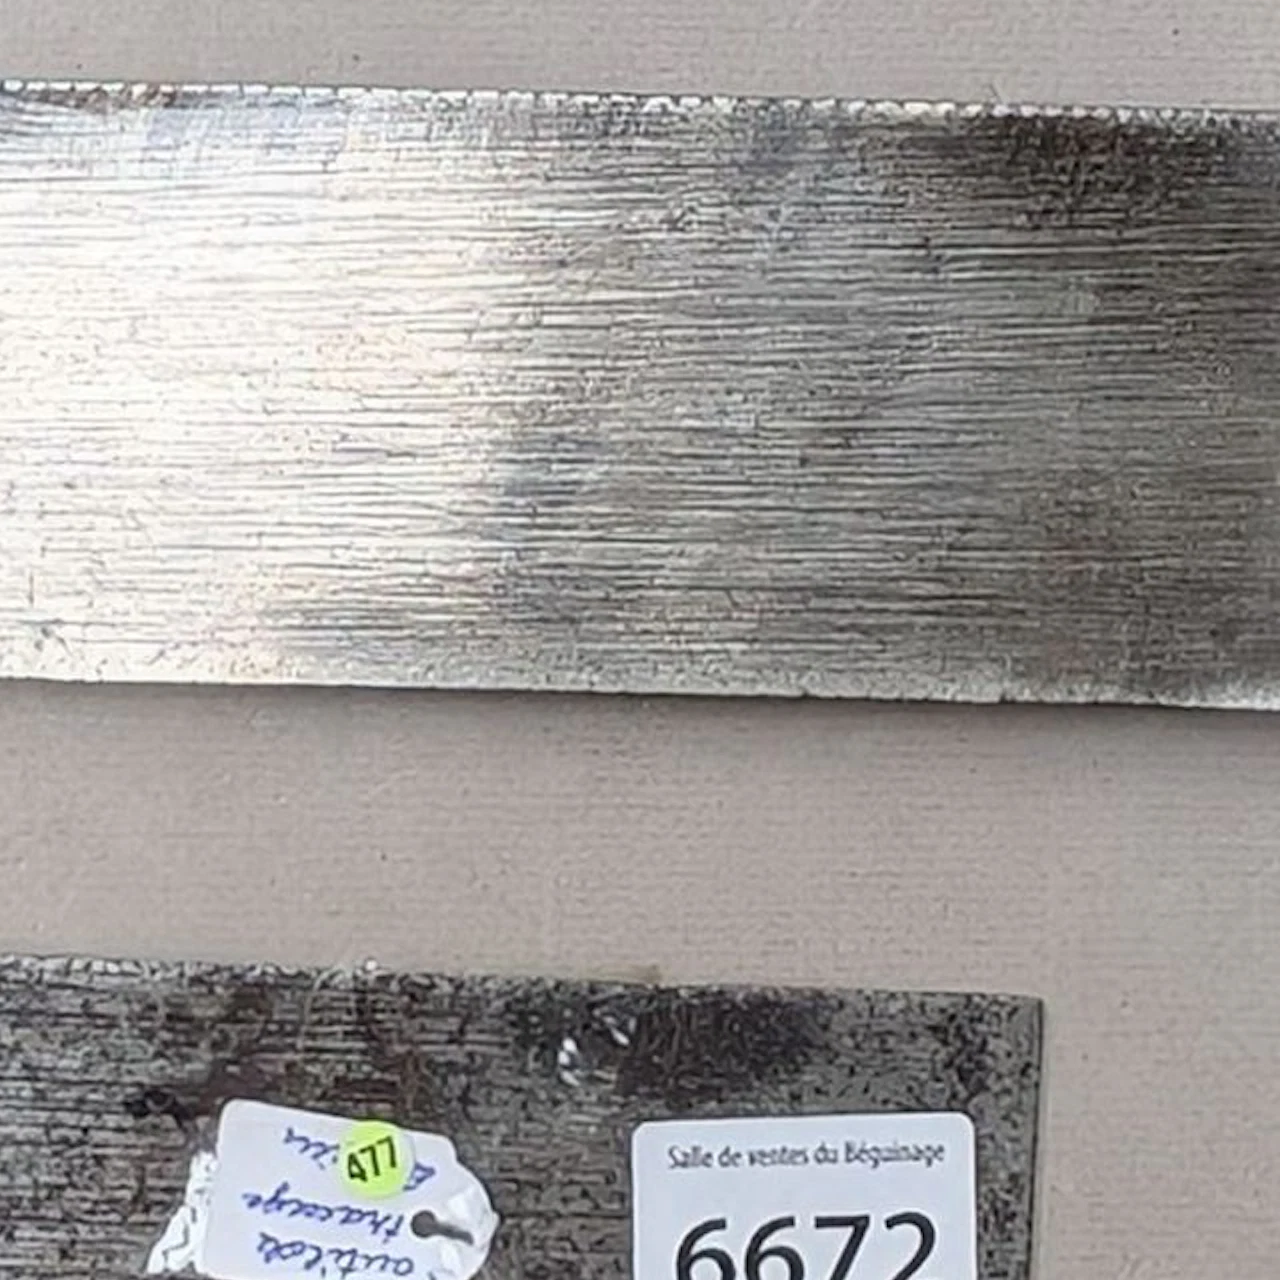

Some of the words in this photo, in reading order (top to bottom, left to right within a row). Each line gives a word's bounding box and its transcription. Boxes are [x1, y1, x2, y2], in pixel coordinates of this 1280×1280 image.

[346, 1136, 398, 1183] 477
[668, 1146, 713, 1169] Salle
[718, 1145, 742, 1167] de
[748, 1146, 809, 1167] ventes
[813, 1143, 838, 1165] du
[844, 1141, 945, 1169] Béguinage
